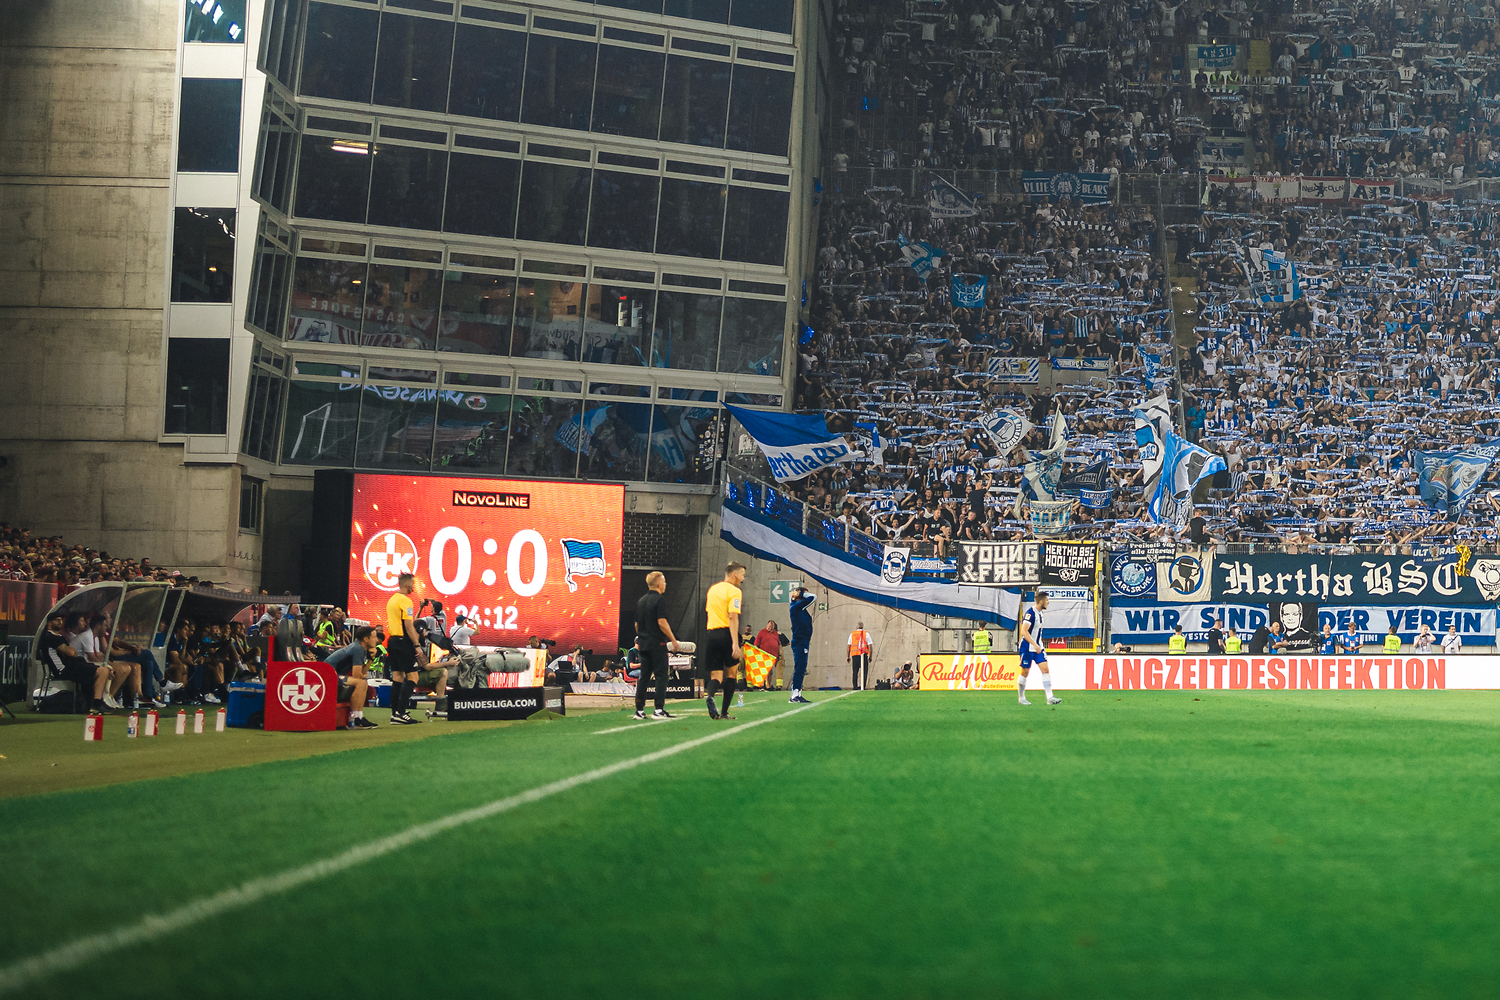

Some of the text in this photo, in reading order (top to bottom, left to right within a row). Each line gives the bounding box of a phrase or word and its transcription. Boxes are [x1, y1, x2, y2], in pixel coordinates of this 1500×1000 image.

[1024, 182, 1107, 195] BLUE BEARS
[962, 545, 1040, 563] YOUNG
[1046, 544, 1095, 557] HERTHA BSC
[429, 526, 549, 597] 0:0
[1045, 556, 1094, 568] HOOLIGANS
[963, 563, 1040, 583] &FREE
[1219, 561, 1353, 600] Hertha
[1361, 561, 1463, 596] BSC
[1126, 607, 1482, 634] WIR SIND DER VEREIN
[923, 661, 1015, 681] Rudolf Weber
[1086, 658, 1445, 689] LANGZEITDESINFEKTION
[454, 699, 536, 709] BUNDESLIGA.COM
